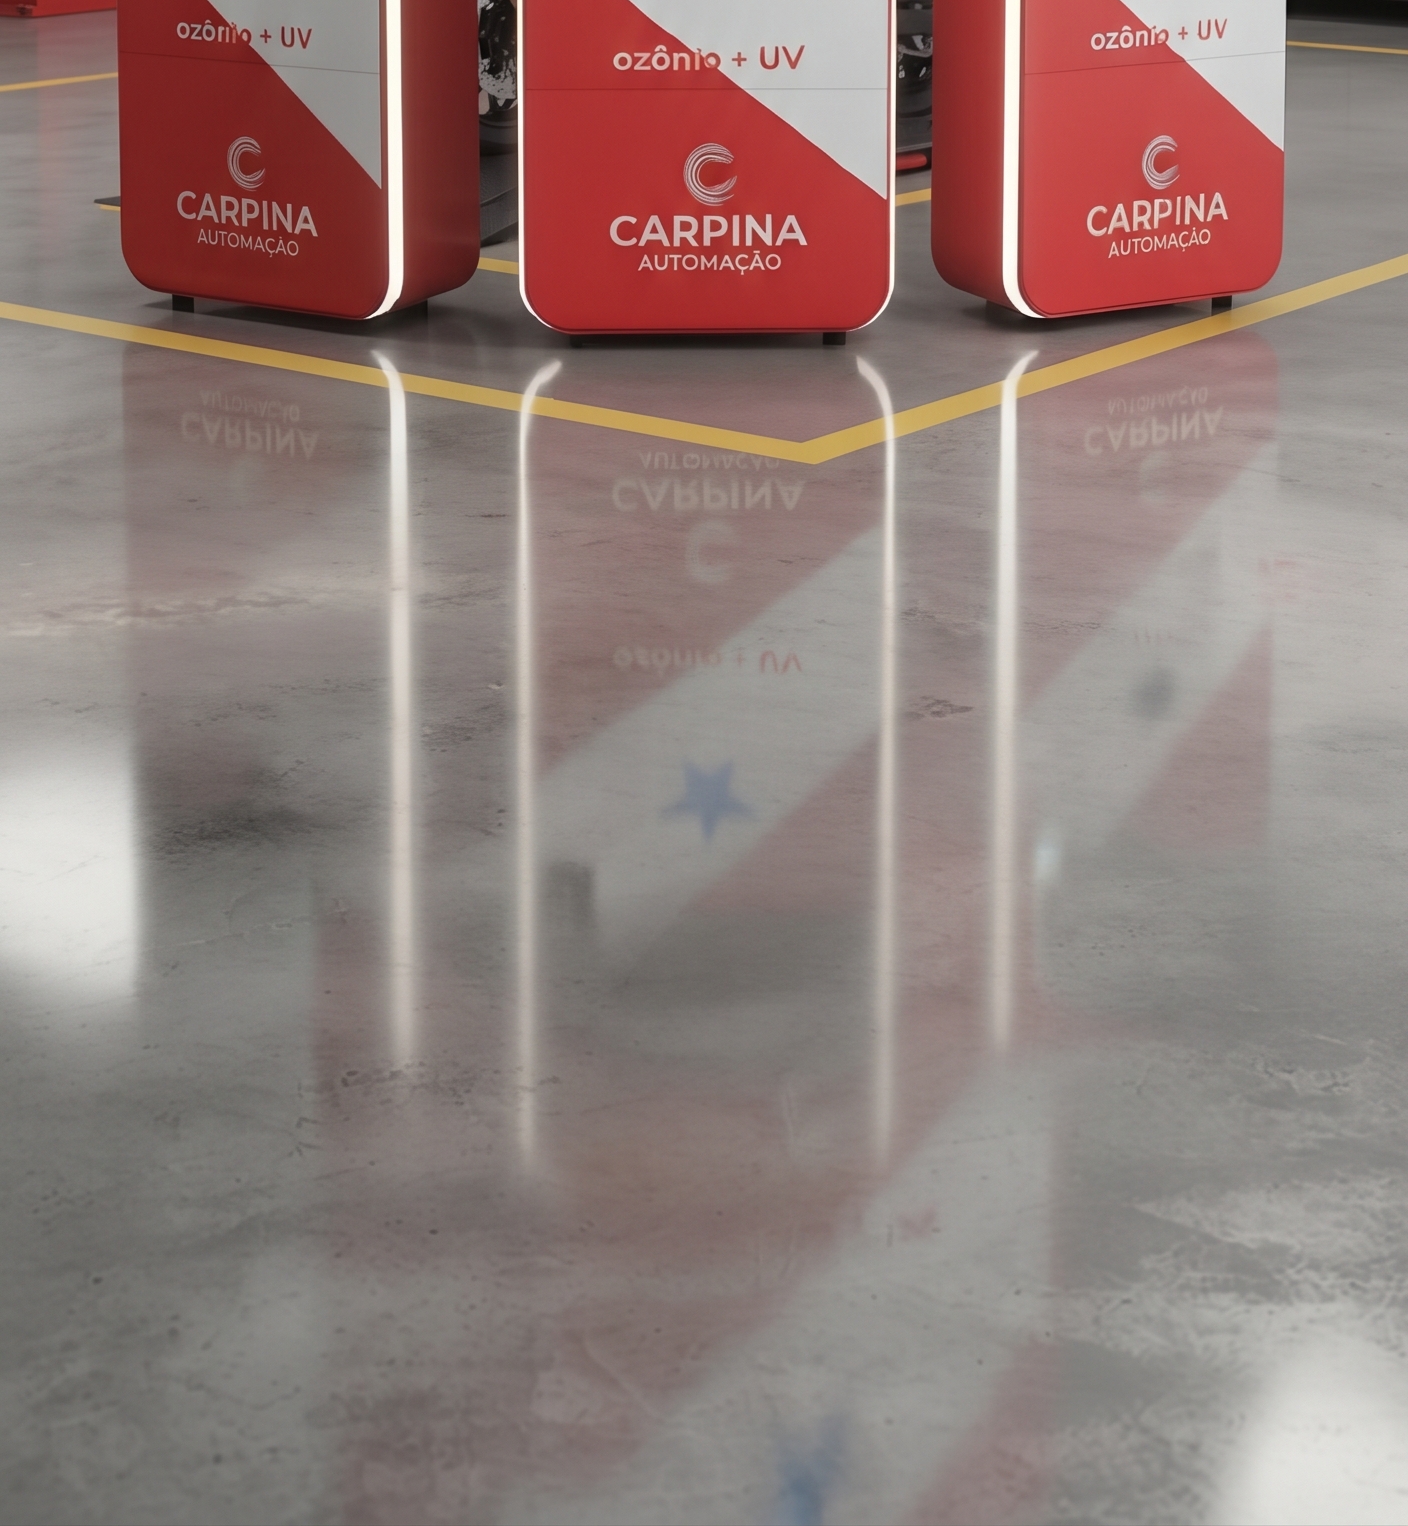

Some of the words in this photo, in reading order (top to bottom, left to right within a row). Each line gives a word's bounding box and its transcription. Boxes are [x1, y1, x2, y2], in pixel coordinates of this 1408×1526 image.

[281, 26, 312, 49] UV
[1197, 18, 1227, 40] UV
[760, 45, 805, 70] UV
[177, 191, 318, 237] CARPINA
[1087, 193, 1228, 237] CARPINA
[609, 215, 807, 247] CARPINA
[638, 251, 782, 275] AUTOMAÇÃO
